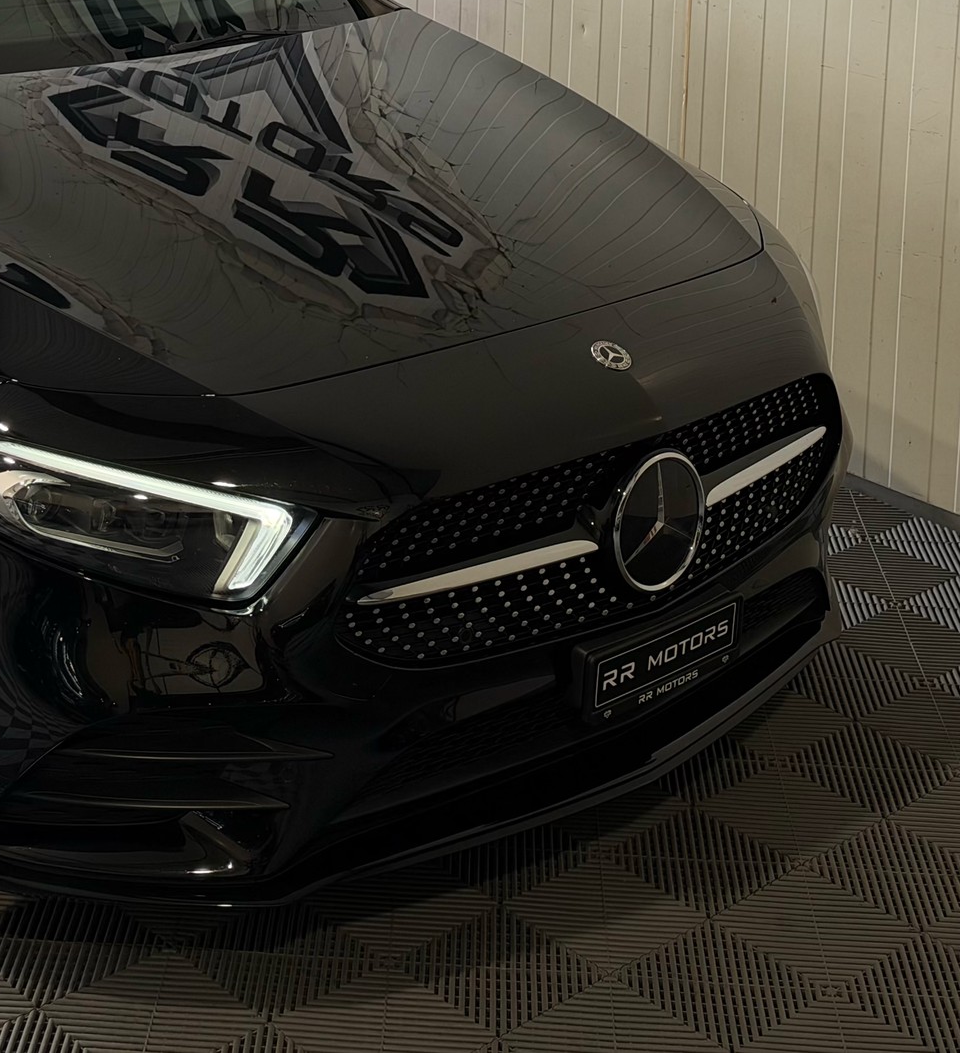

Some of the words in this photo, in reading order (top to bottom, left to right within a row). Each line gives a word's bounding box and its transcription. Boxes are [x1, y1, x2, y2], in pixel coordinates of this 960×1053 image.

[602, 661, 636, 691] RR
[647, 619, 729, 671] MOTORS
[638, 691, 653, 704] RR
[656, 669, 699, 696] MOTORS
